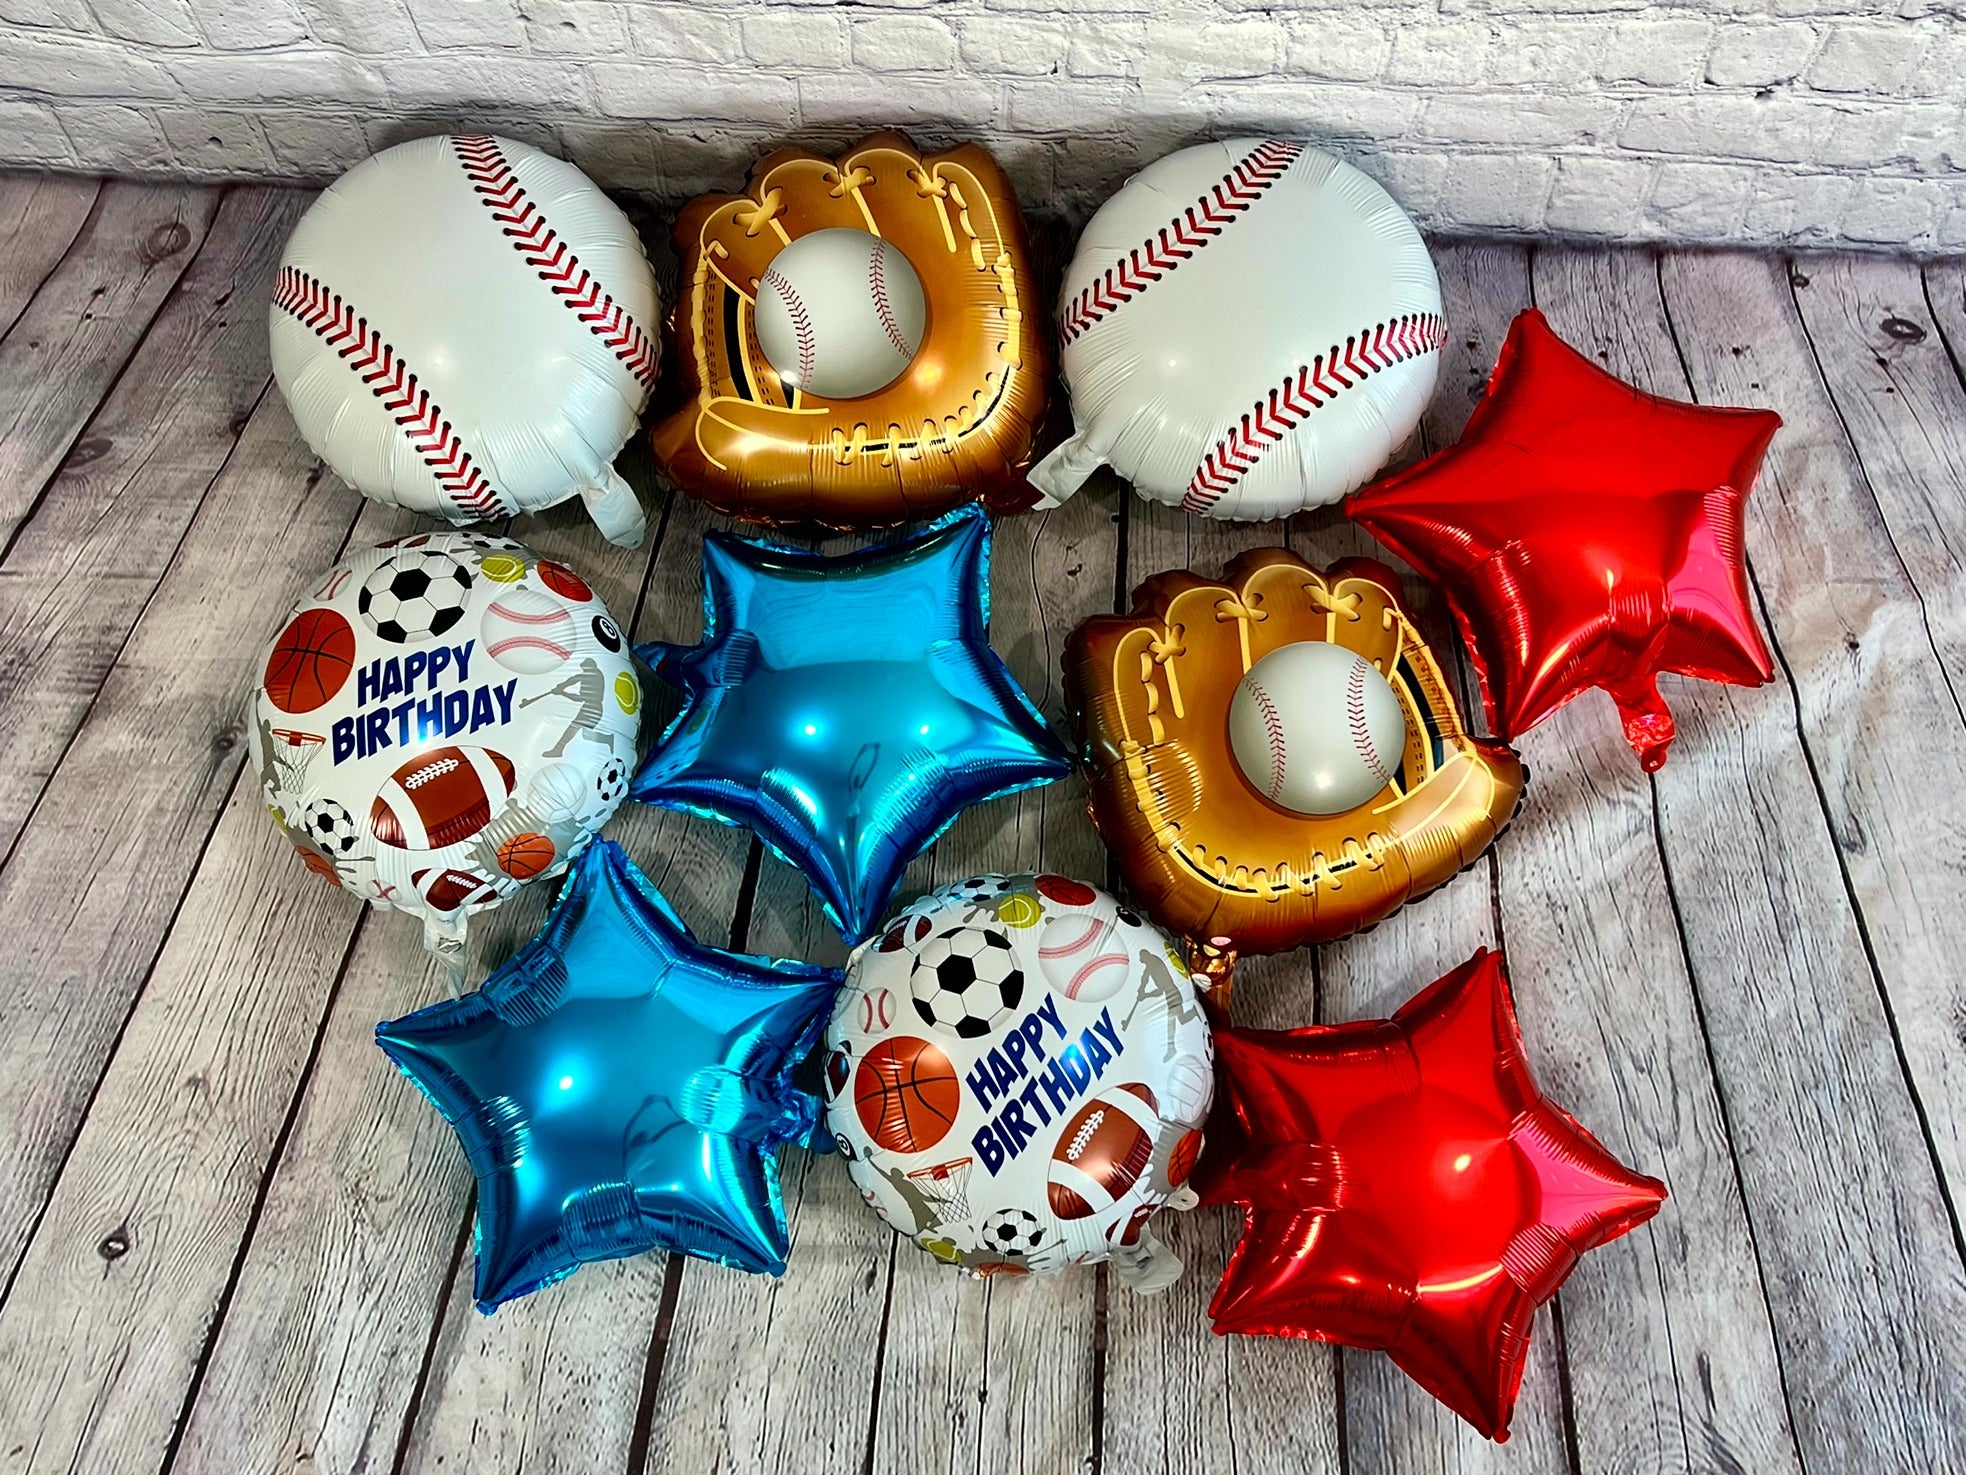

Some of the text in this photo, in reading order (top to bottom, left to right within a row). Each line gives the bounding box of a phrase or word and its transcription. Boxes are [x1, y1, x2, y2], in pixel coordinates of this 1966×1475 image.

[601, 620, 616, 637] 8
[357, 639, 476, 708] HAPPY
[331, 678, 518, 766] BIRTHDAY
[966, 992, 1067, 1113] HAPPY
[971, 1006, 1125, 1178] BIRTHDAY
